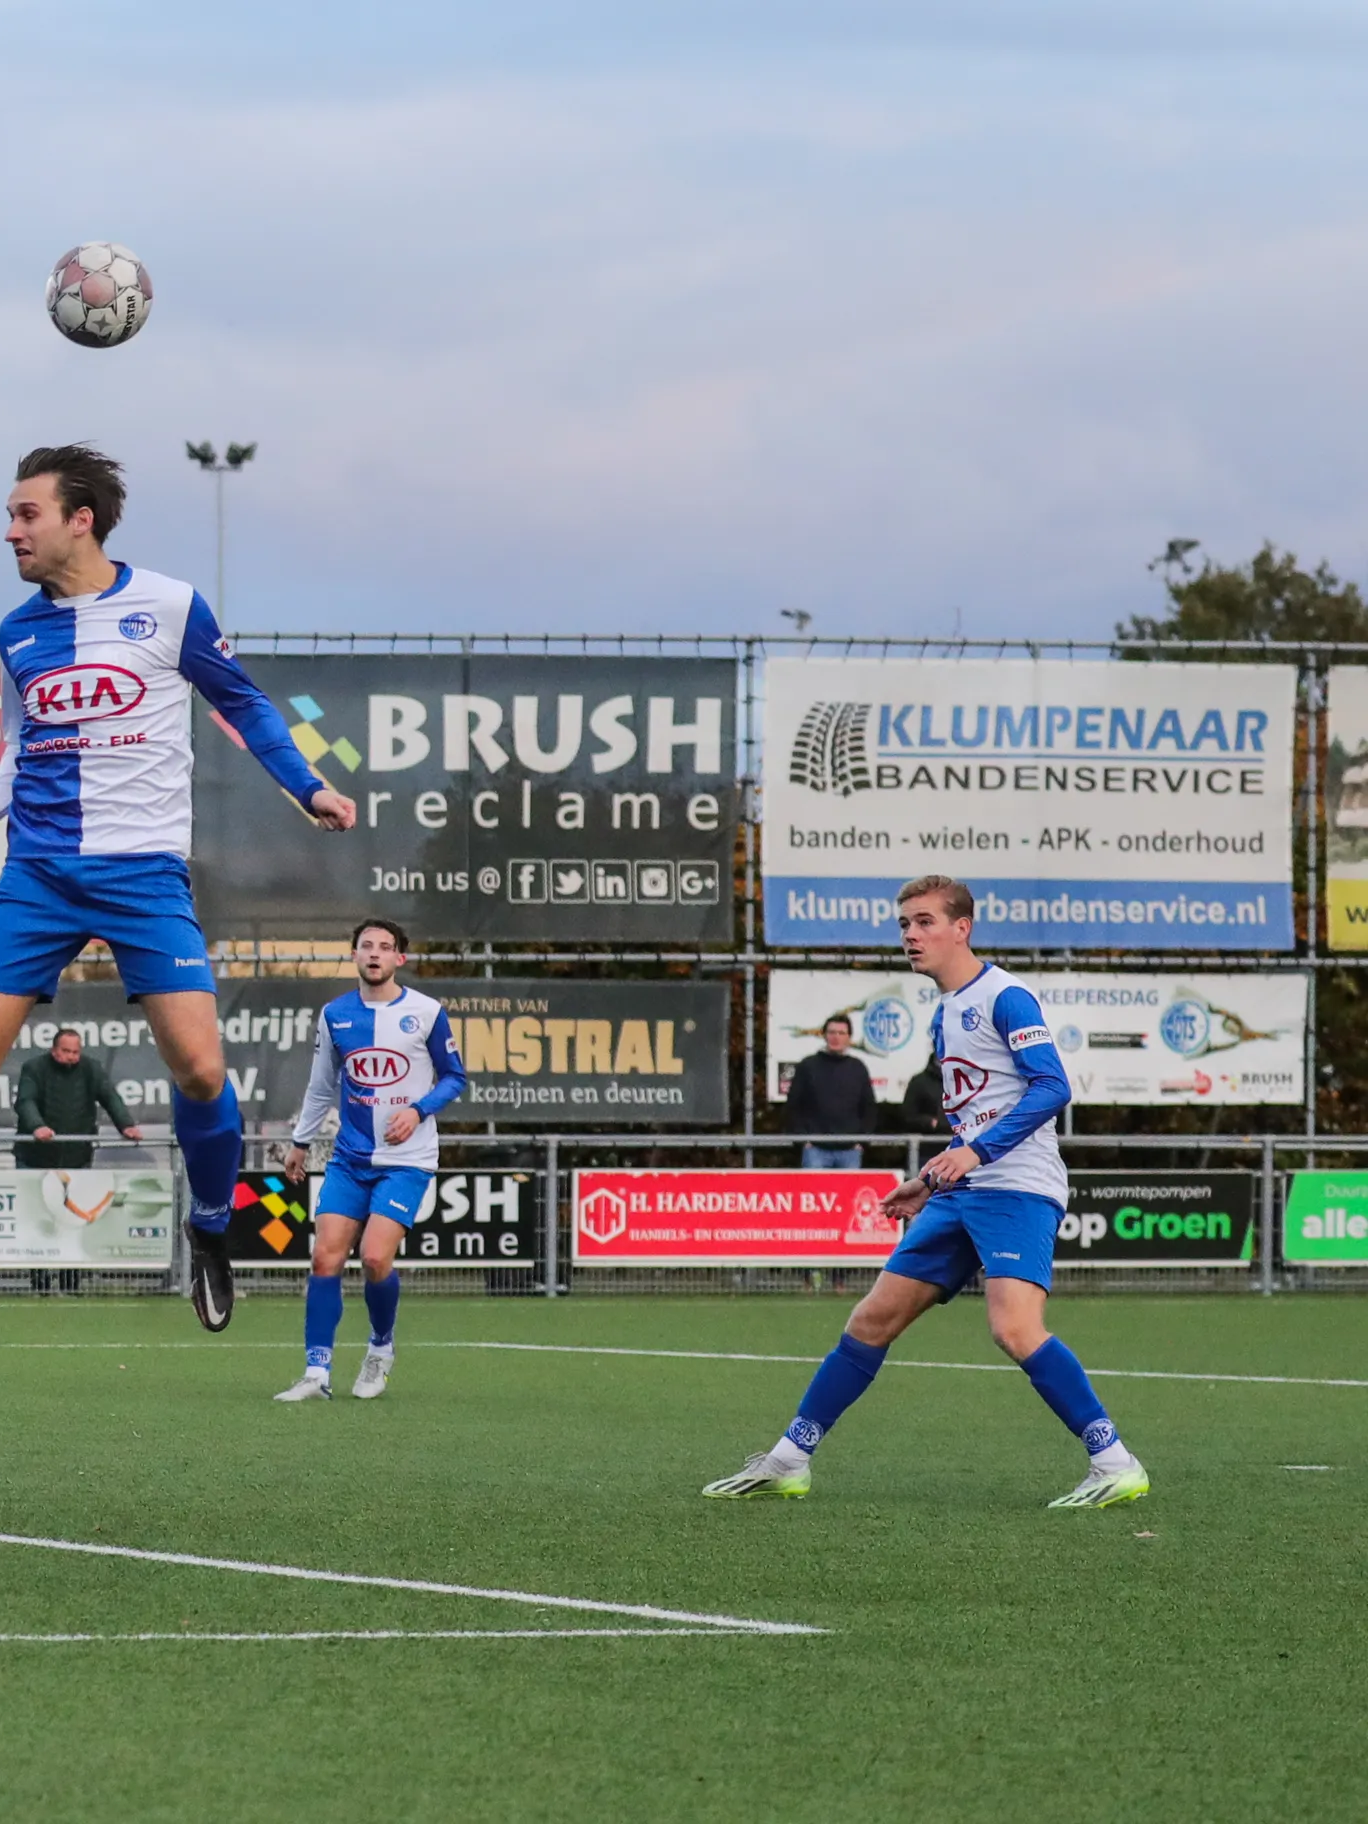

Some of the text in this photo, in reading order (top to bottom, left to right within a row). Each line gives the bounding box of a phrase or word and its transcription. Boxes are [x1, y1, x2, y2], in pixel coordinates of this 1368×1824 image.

[36, 677, 123, 715] KIA
[368, 694, 721, 774] BRUSH
[877, 704, 1268, 752] KLUMPENAAR
[875, 765, 1265, 795] BANDENSERVICE
[367, 779, 720, 830] reclame
[789, 825, 891, 850] banden
[919, 826, 1010, 851] wielen
[1038, 828, 1092, 852] APK
[1117, 830, 1265, 855] onderhoud
[369, 867, 425, 893] Join
[436, 871, 469, 892] us
[476, 867, 501, 895] @
[788, 891, 1266, 925] klumprbandenservice.nl
[439, 997, 549, 1013] PARTNER VAN
[1038, 988, 1159, 1006] KEEPERSDAG
[351, 1057, 399, 1078] KIA
[390, 1096, 409, 1105] EDE
[469, 1081, 684, 1108] kozijnen en deuren
[975, 1108, 999, 1126] EDE
[630, 1192, 842, 1213] H. HARDEMAN B.V.
[1091, 1184, 1212, 1201] warmtepompen
[630, 1228, 693, 1242] HANDELS-
[695, 1228, 712, 1242] EN
[1114, 1206, 1231, 1240] Groen
